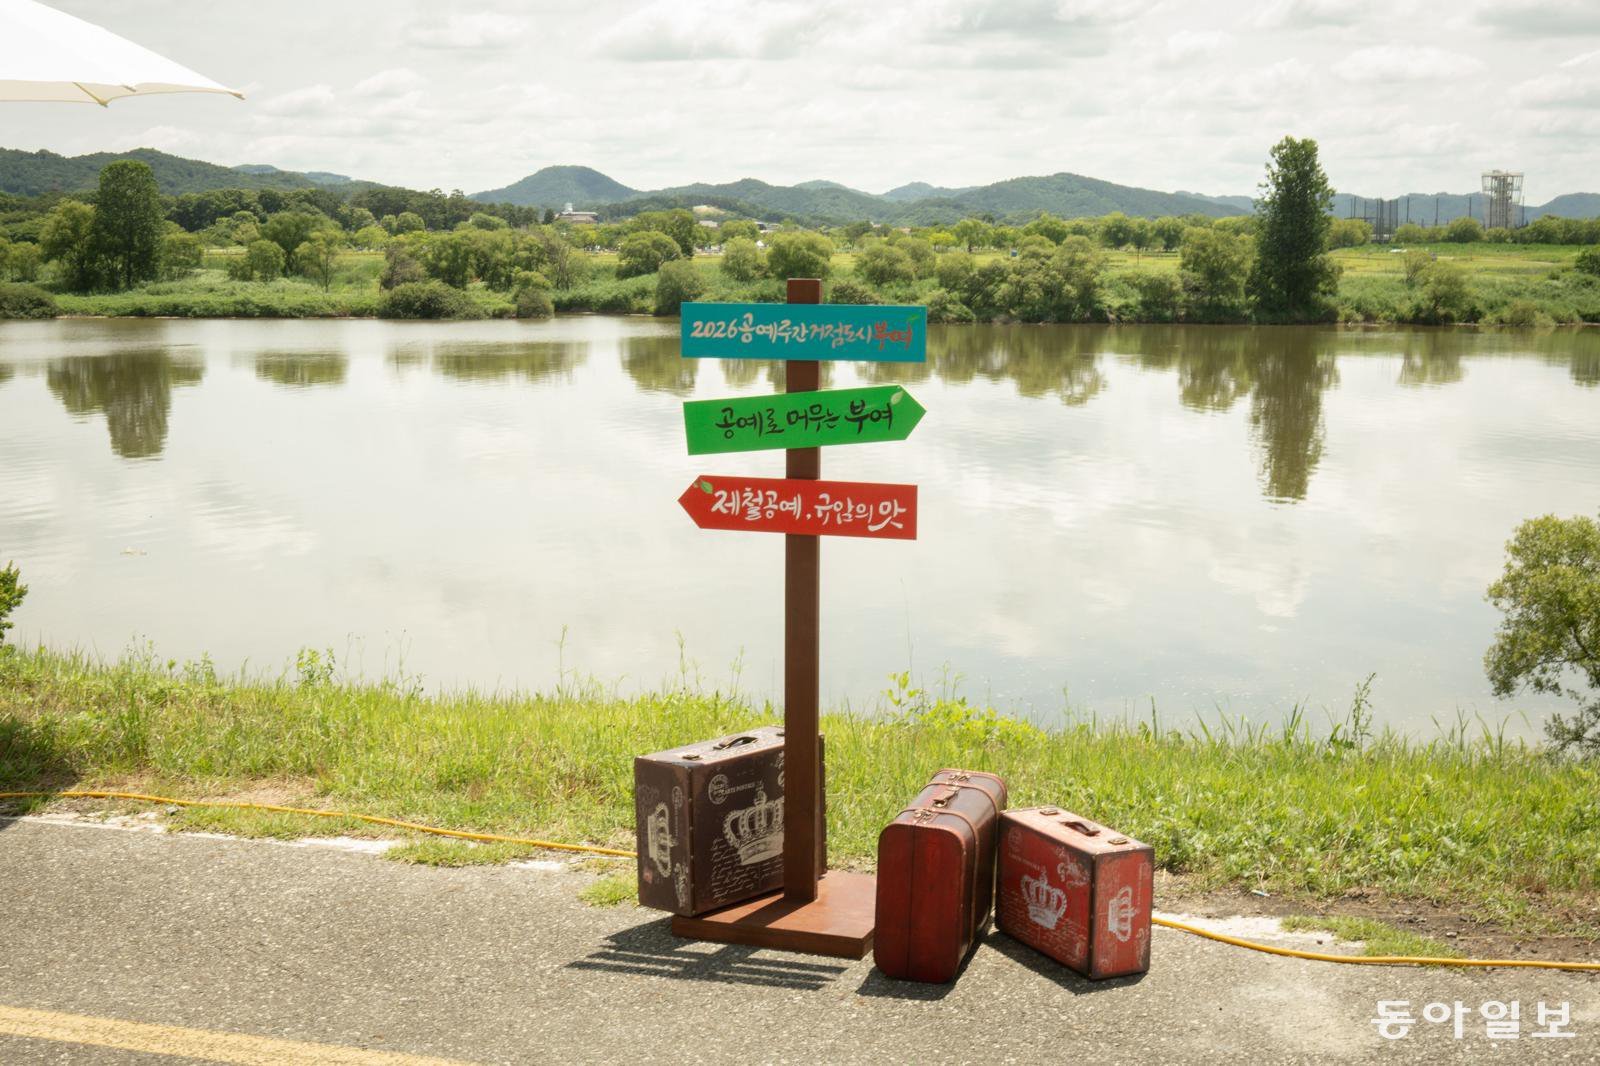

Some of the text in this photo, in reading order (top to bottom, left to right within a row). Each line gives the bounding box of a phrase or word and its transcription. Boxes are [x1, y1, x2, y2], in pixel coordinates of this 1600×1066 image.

[715, 399, 893, 439] 공예로 머무는 부여
[814, 493, 873, 526] 규암의
[867, 499, 907, 532] 맛
